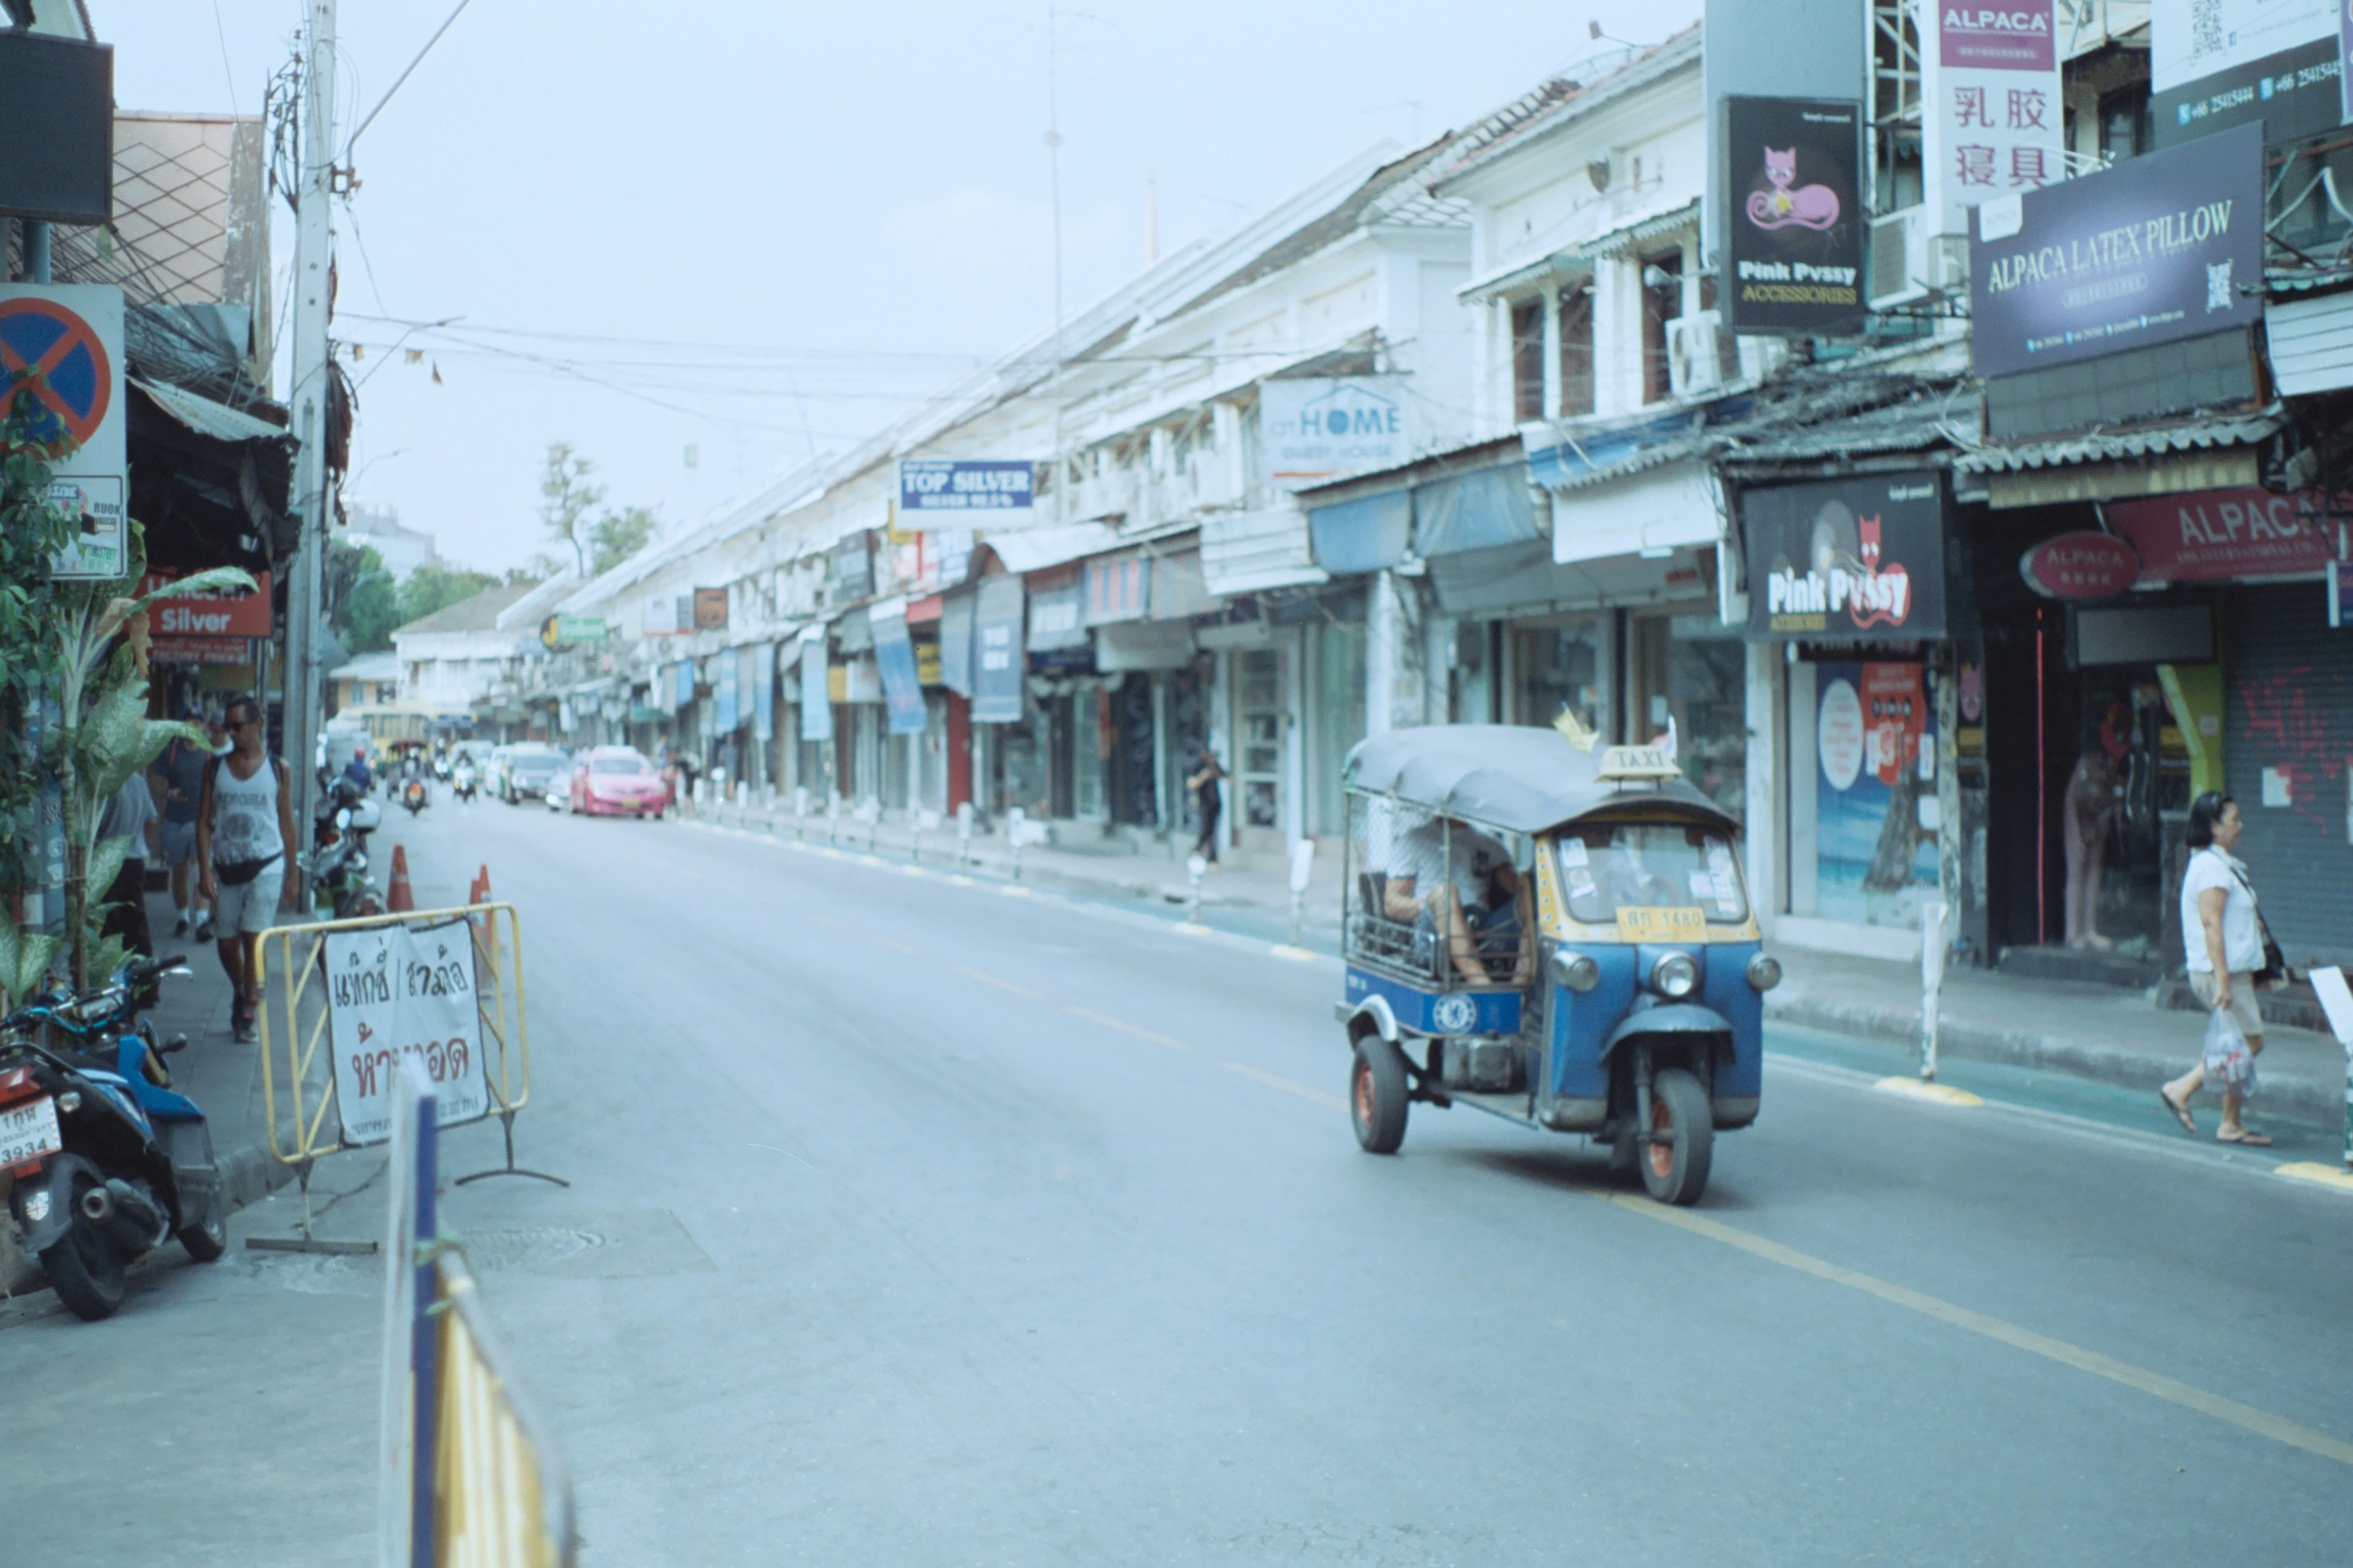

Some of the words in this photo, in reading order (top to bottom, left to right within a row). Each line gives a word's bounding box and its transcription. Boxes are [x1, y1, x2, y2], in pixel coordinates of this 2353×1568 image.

[1943, 9, 2047, 31] ALPACA
[1955, 86, 2048, 130] 乳胶
[1988, 245, 2067, 294] ALPACA
[2071, 223, 2142, 273] LATEX
[2145, 198, 2232, 254] PILLOW
[1738, 260, 1791, 282] Pink
[1741, 284, 1858, 306] ACCESSORIES
[904, 470, 950, 494] TOP
[952, 470, 1030, 492] SILVER
[2047, 547, 2123, 568] ALPACA
[1768, 566, 1827, 614] Pink
[161, 606, 231, 633] Silver
[1615, 750, 1666, 768] TAXI
[2, 1137, 48, 1164] 3934
